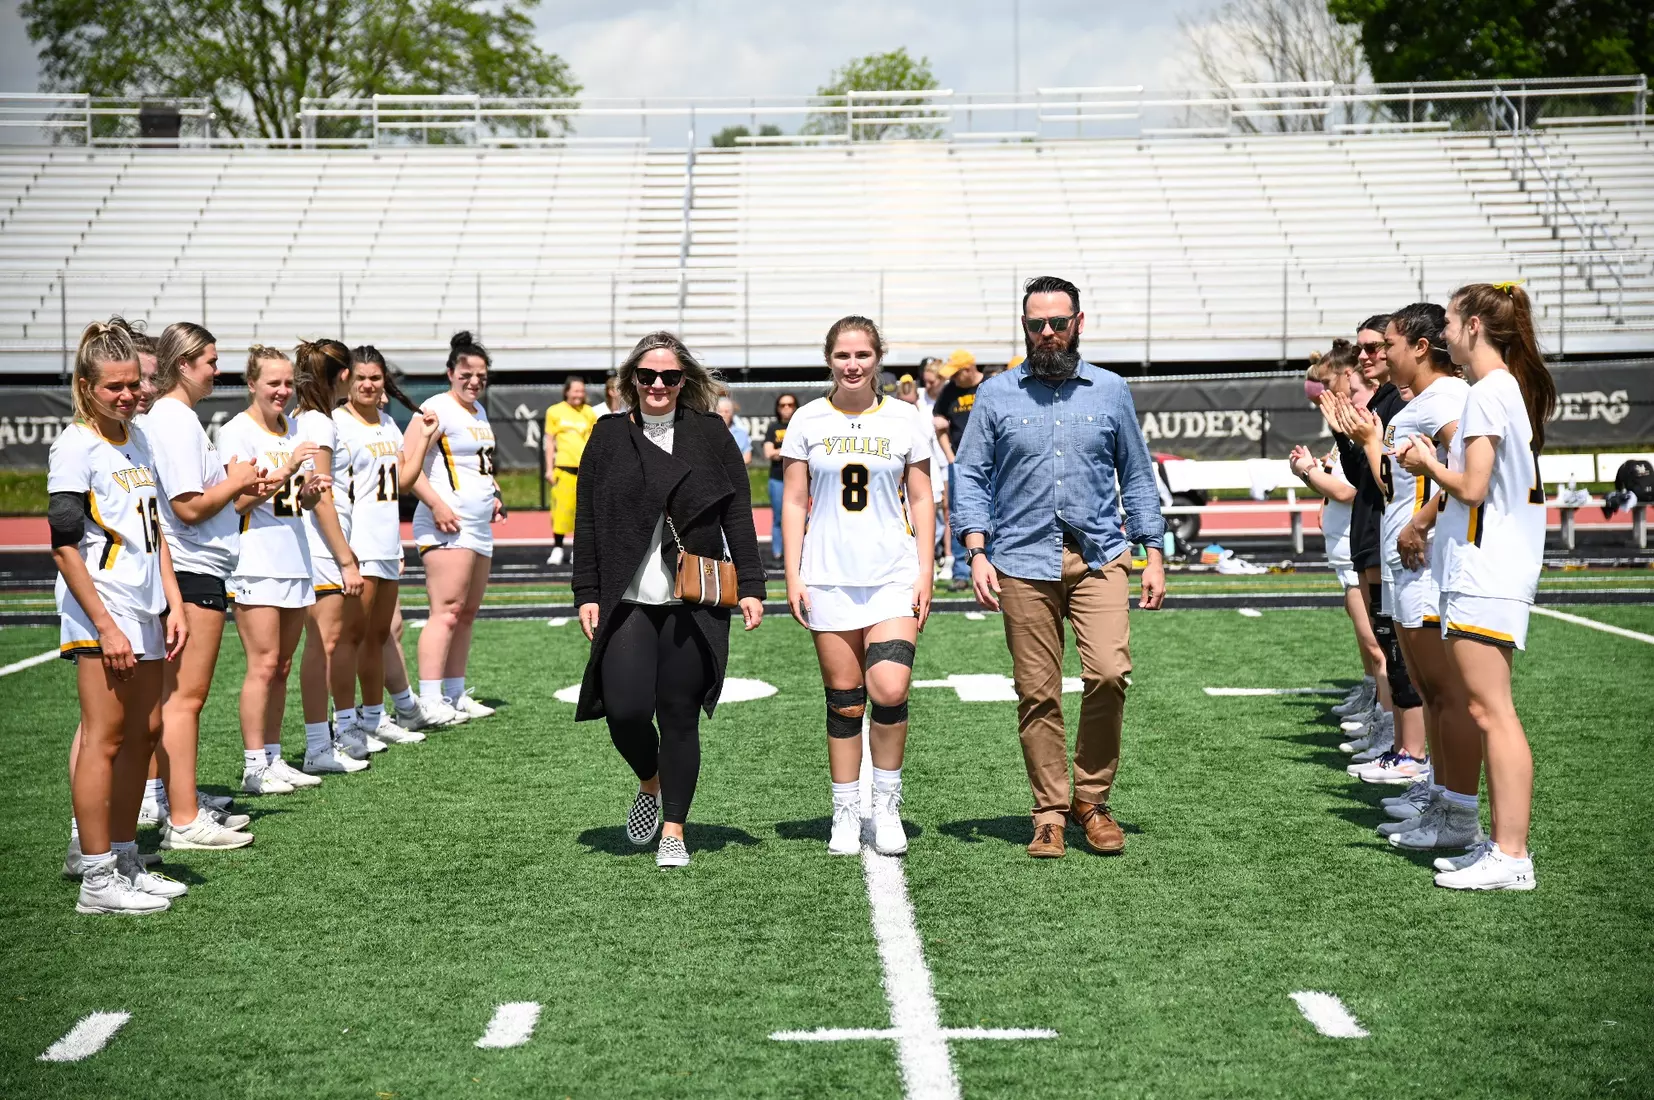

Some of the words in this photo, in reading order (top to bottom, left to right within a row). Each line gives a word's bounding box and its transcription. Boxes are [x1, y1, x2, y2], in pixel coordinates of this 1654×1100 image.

[0, 416, 74, 449] AUD
[823, 436, 891, 460] VILLE
[376, 463, 398, 502] 11
[841, 463, 870, 512] 8
